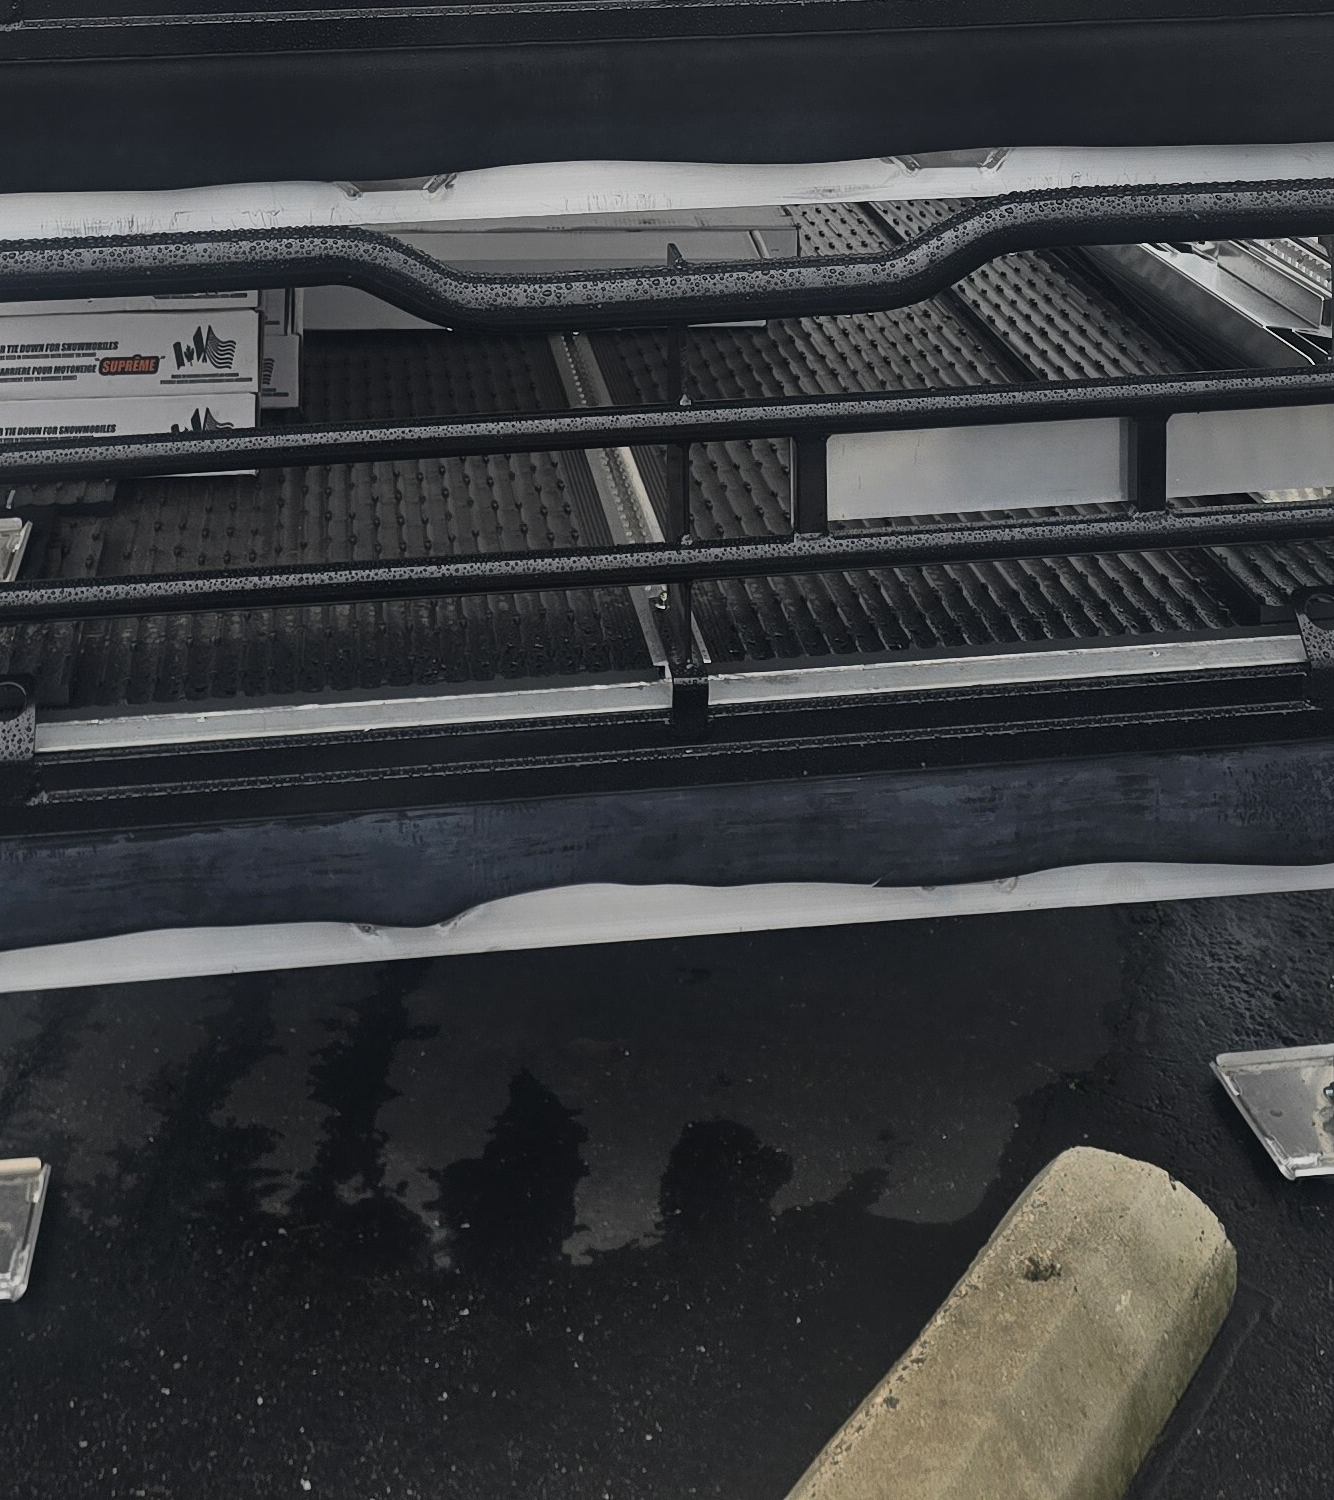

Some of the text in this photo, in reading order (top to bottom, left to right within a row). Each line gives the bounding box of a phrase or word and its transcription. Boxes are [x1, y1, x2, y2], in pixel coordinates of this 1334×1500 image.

[20, 343, 45, 353] DOWN
[45, 342, 61, 352] FOR
[61, 341, 119, 352] SNOWMOBILES
[32, 365, 53, 375] POUR
[17, 426, 42, 436] DOWN
[43, 425, 58, 435] FOR
[58, 424, 117, 435] SNOWMOBILES
